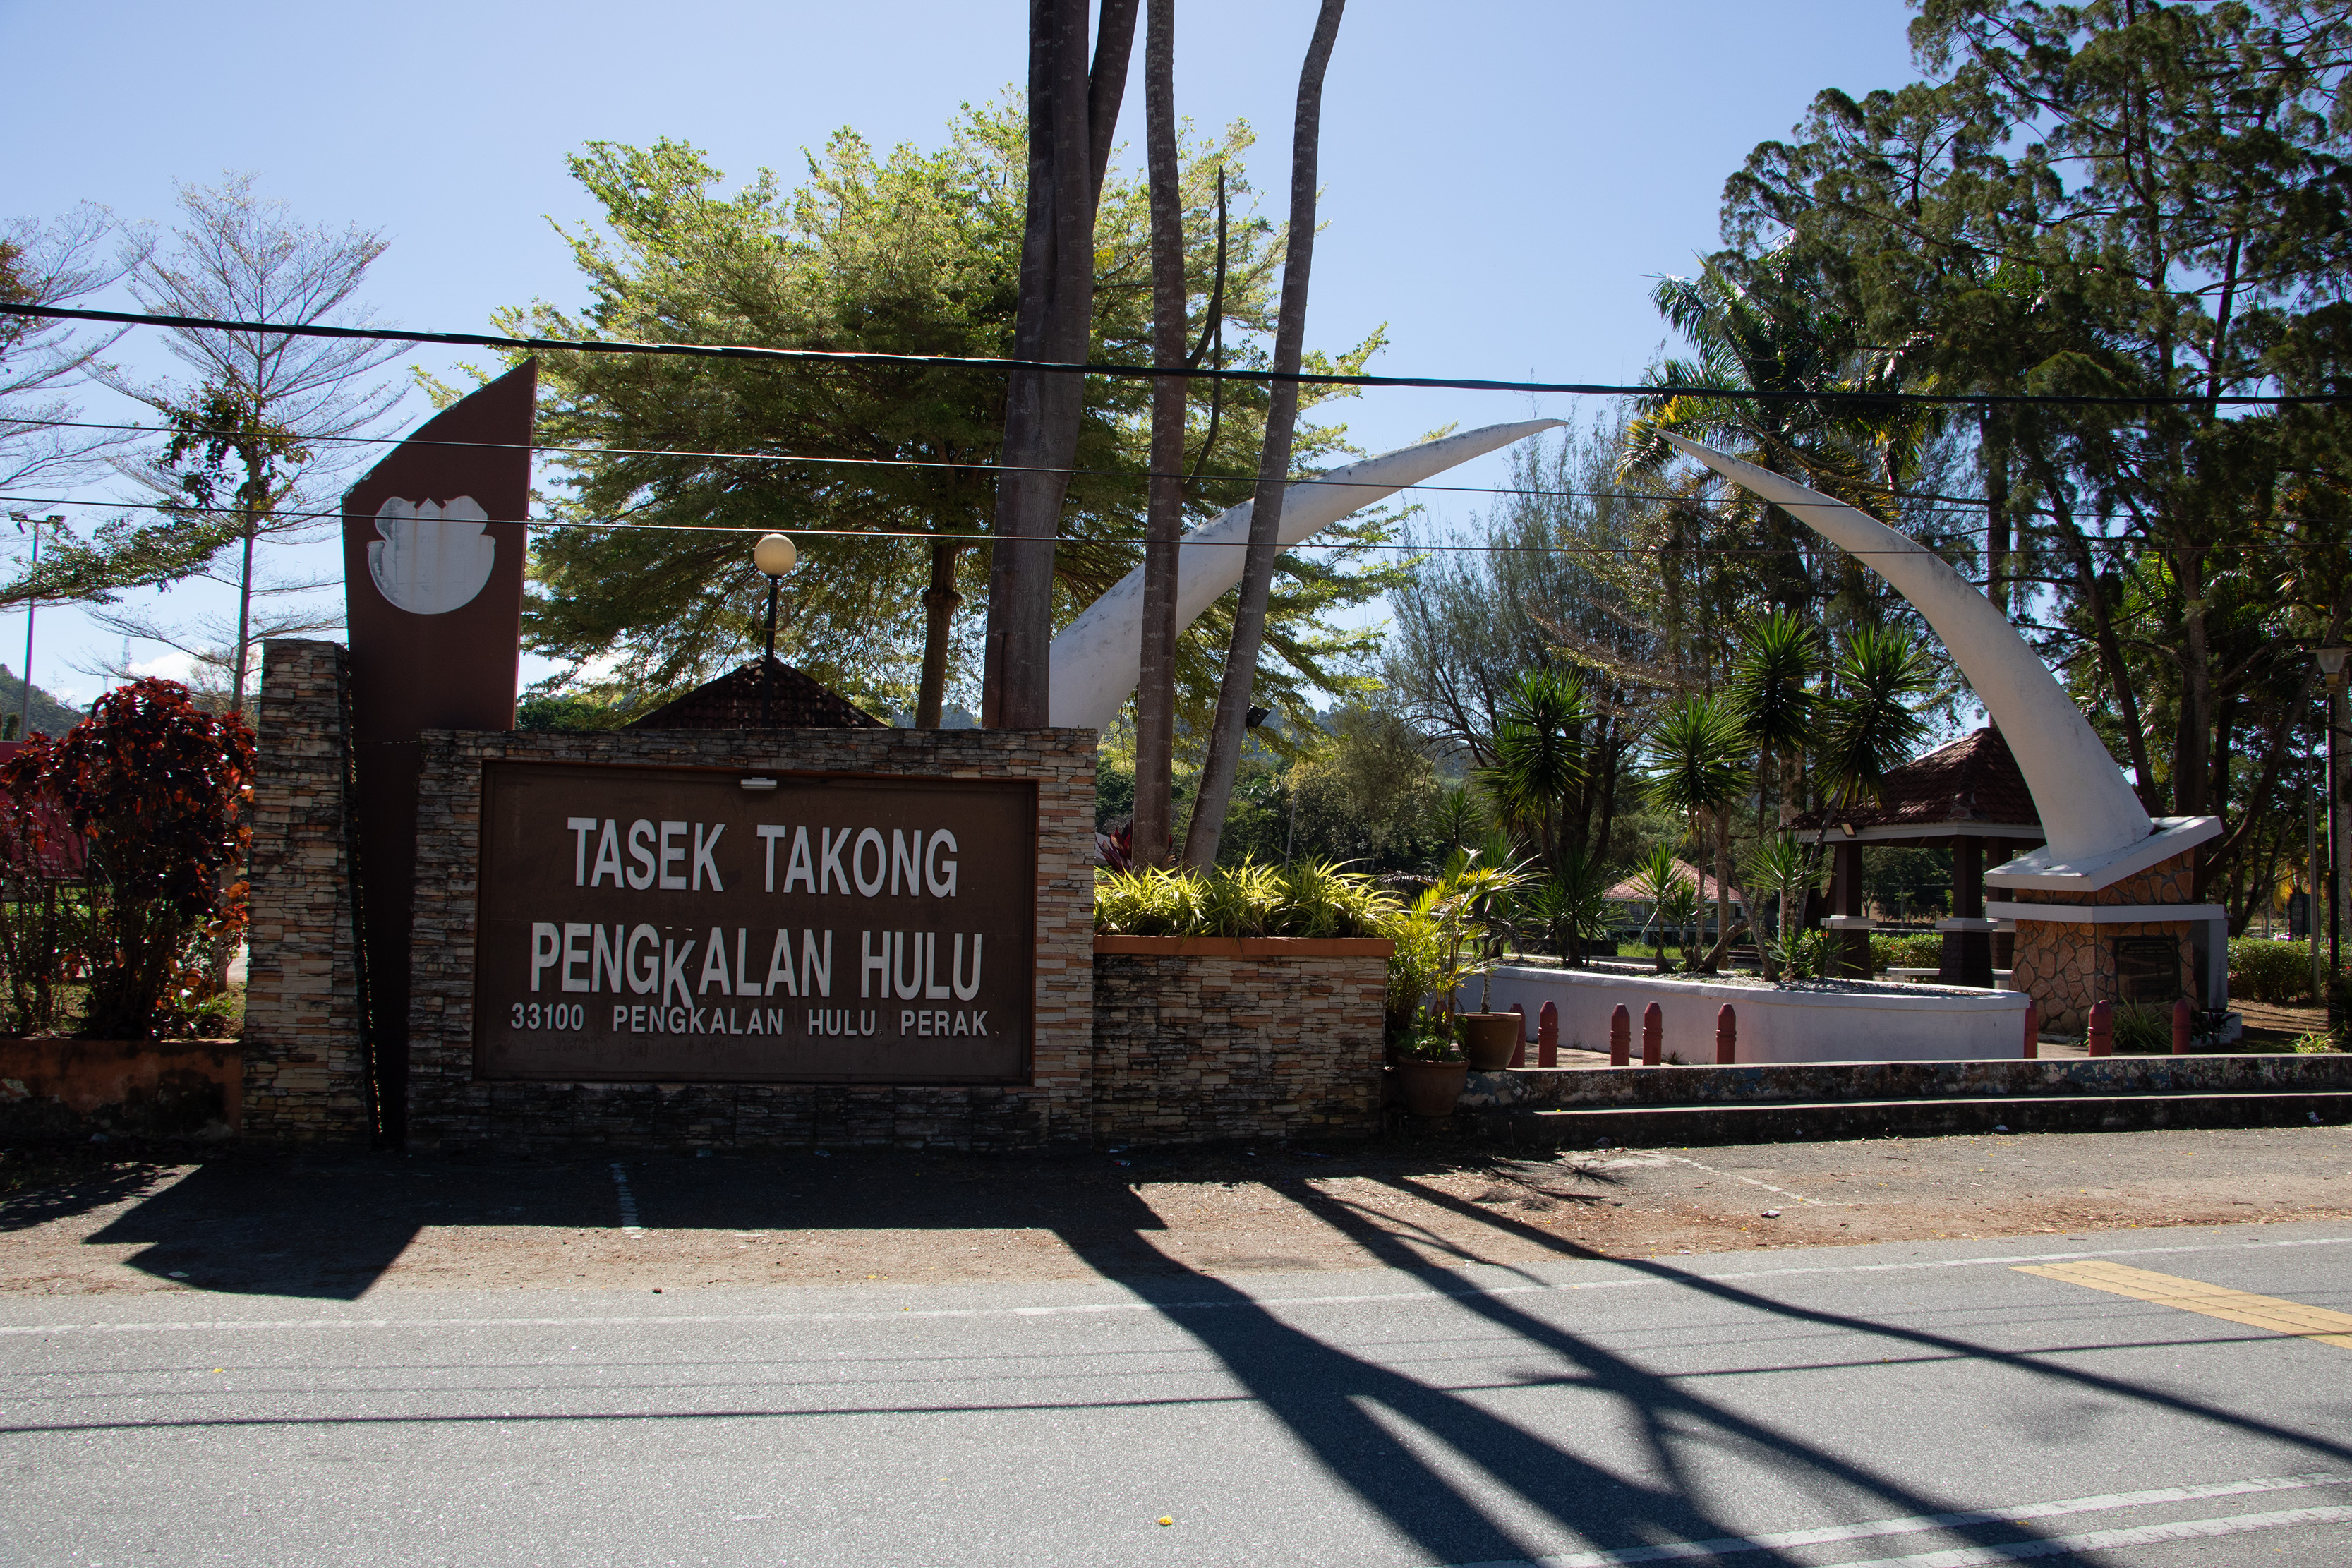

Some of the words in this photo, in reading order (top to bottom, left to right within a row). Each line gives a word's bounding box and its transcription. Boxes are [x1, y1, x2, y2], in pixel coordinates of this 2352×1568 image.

[567, 816, 725, 892] TASEK
[756, 824, 958, 898] TAKONG
[530, 922, 833, 1008] PENGKALAN
[860, 930, 982, 1001] HULU
[511, 1003, 584, 1030] 33100
[613, 1005, 783, 1035] PENGKALAN
[807, 1008, 876, 1036] HULU
[900, 1010, 989, 1037] PERAK
